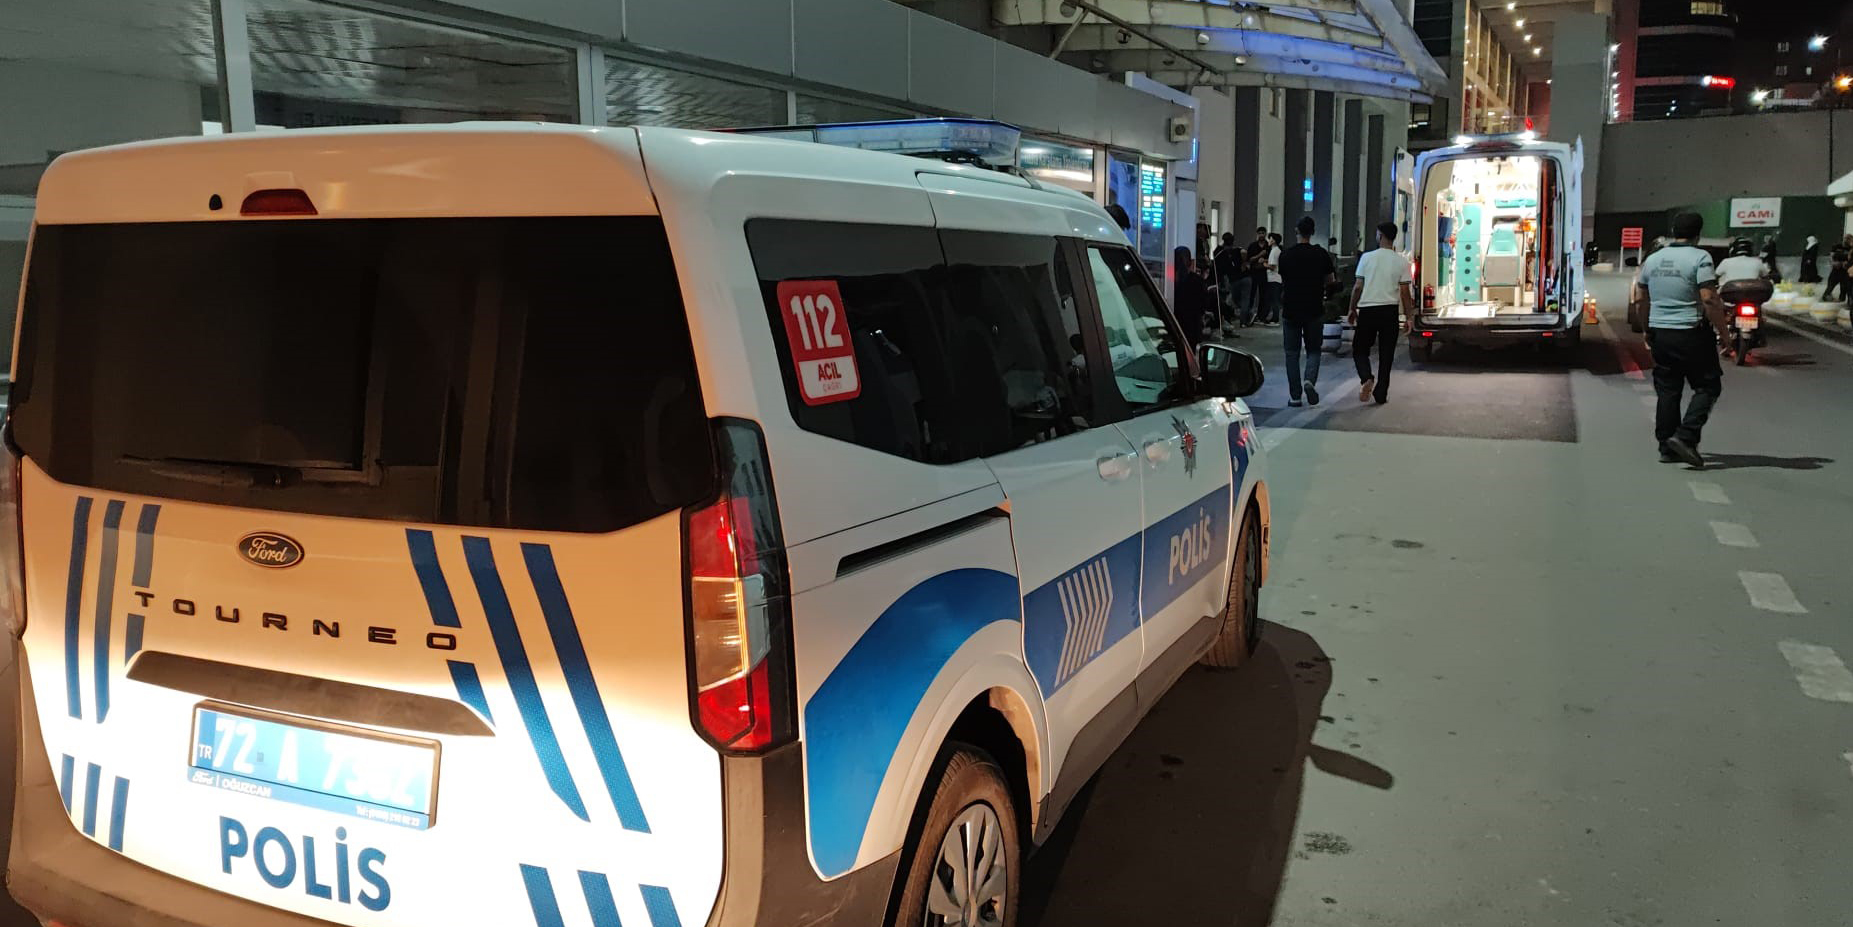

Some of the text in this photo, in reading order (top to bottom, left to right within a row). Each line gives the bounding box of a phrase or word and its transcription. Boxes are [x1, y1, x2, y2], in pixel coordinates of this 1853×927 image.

[790, 293, 844, 351] 112
[247, 536, 288, 563] Ford
[134, 591, 457, 651] TOURNEO
[199, 743, 212, 760] TR
[212, 717, 257, 774] 72
[276, 729, 299, 784] A
[219, 815, 391, 912] POLİS
